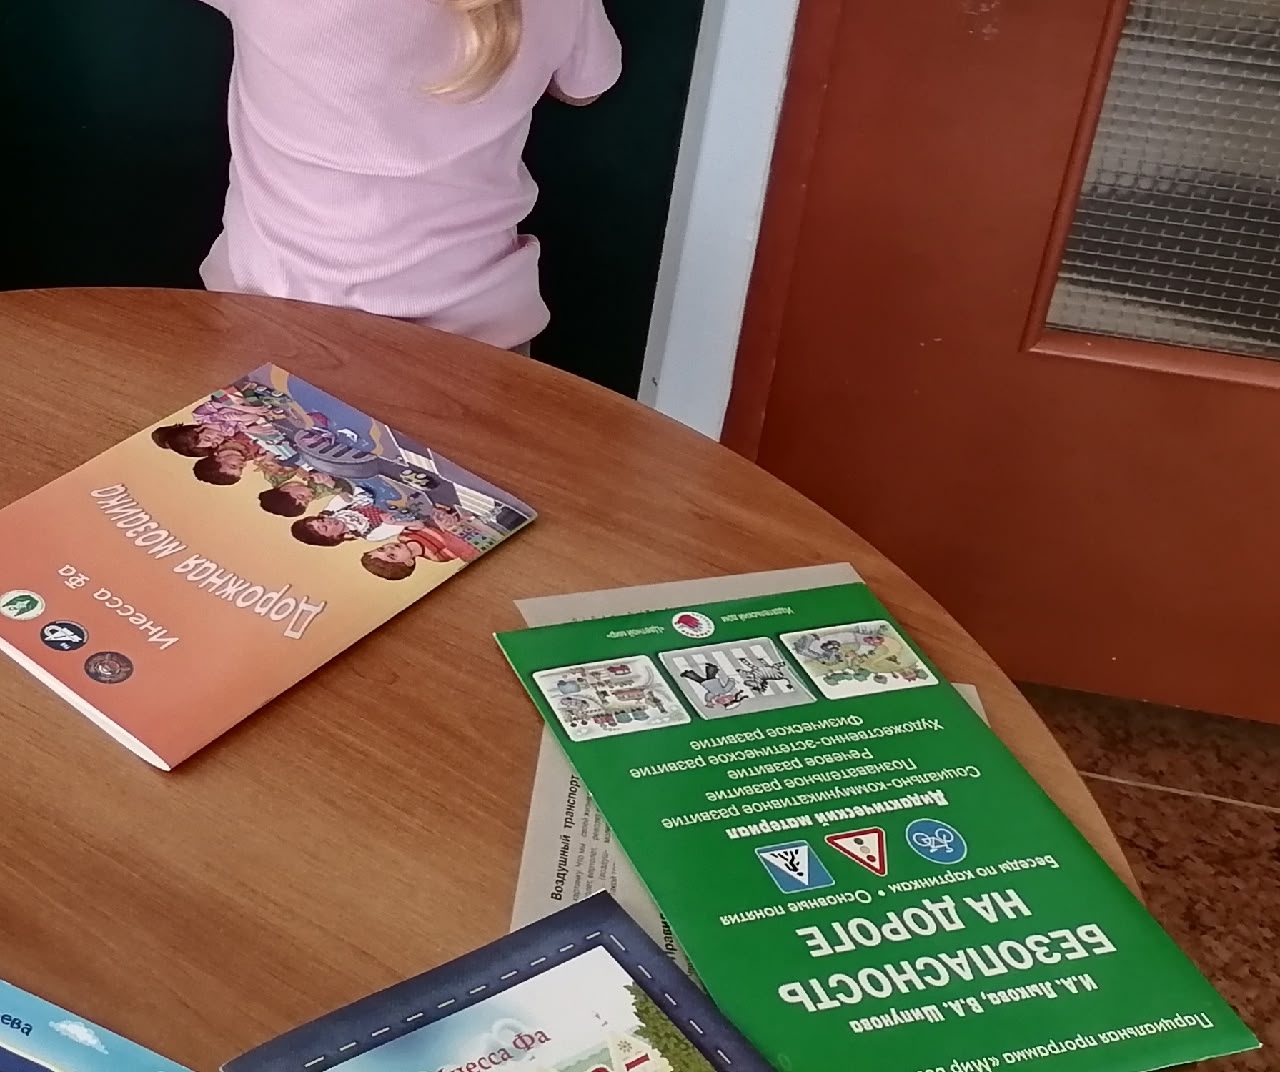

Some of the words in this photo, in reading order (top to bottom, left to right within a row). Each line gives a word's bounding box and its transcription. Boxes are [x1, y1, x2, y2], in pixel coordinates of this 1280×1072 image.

[89, 483, 188, 560] мозаика
[58, 564, 91, 589] Фа
[173, 552, 328, 640] Дорожная
[93, 587, 180, 650] Инесса
[767, 714, 864, 738] Физическое
[689, 728, 766, 751] развитие
[707, 718, 945, 766] Художественно-эстетическое
[629, 754, 707, 779] развитие
[727, 757, 804, 780] развитие
[804, 747, 874, 767] Речевое
[783, 758, 918, 789] Познавательное
[705, 778, 783, 802] развитие
[741, 765, 981, 814] Социально-коммуникативное
[661, 803, 741, 829] развитие
[814, 789, 949, 827] Дидактический
[550, 834, 571, 902] Воздушный
[564, 774, 581, 830] транспорт
[725, 814, 814, 840] материал
[976, 865, 997, 878] по
[999, 854, 1060, 875] Беседы
[888, 870, 974, 893] картинкам
[787, 889, 873, 913] Основные
[963, 888, 1032, 924] НА
[719, 905, 786, 927] понятия
[795, 894, 966, 958] ДОРОГЕ
[777, 923, 1117, 1013] БЕЗОПАСНОСТЬ
[981, 979, 1058, 1006] Лыкова,
[1057, 973, 1099, 995] И.А.
[849, 1005, 946, 1034] Шипунова
[942, 996, 984, 1018] В.А.
[1099, 1012, 1215, 1044] Парциальная
[438, 1048, 514, 1072] есса
[512, 1028, 552, 1053] Фа
[1005, 1036, 1098, 1066] программа
